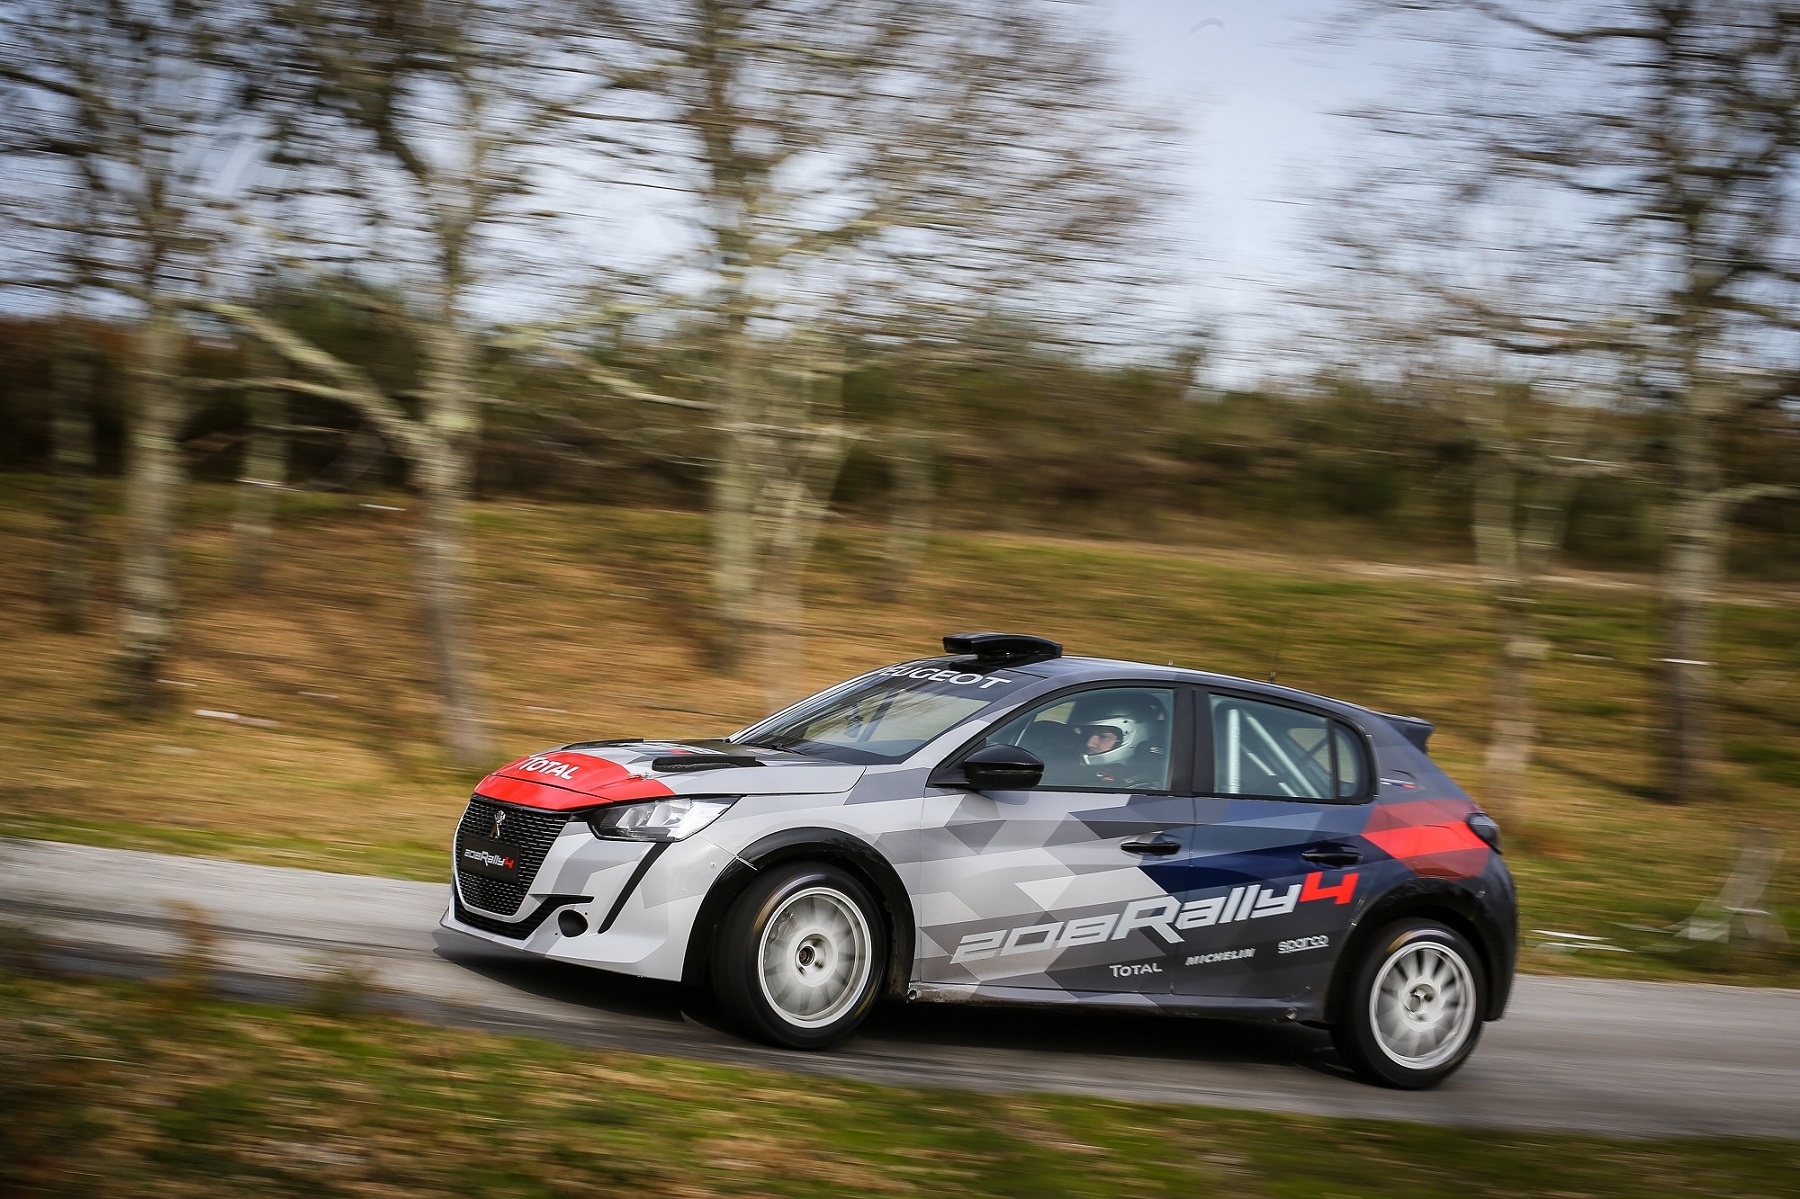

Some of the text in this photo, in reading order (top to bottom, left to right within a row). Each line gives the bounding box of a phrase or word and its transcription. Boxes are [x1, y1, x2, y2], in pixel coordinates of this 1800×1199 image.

[879, 665, 1012, 689] EUGEOT
[519, 757, 580, 780] TOTAL
[1278, 935, 1329, 954] sparco
[1184, 948, 1256, 966] MICHELIN
[1109, 962, 1163, 978] TOTAL
